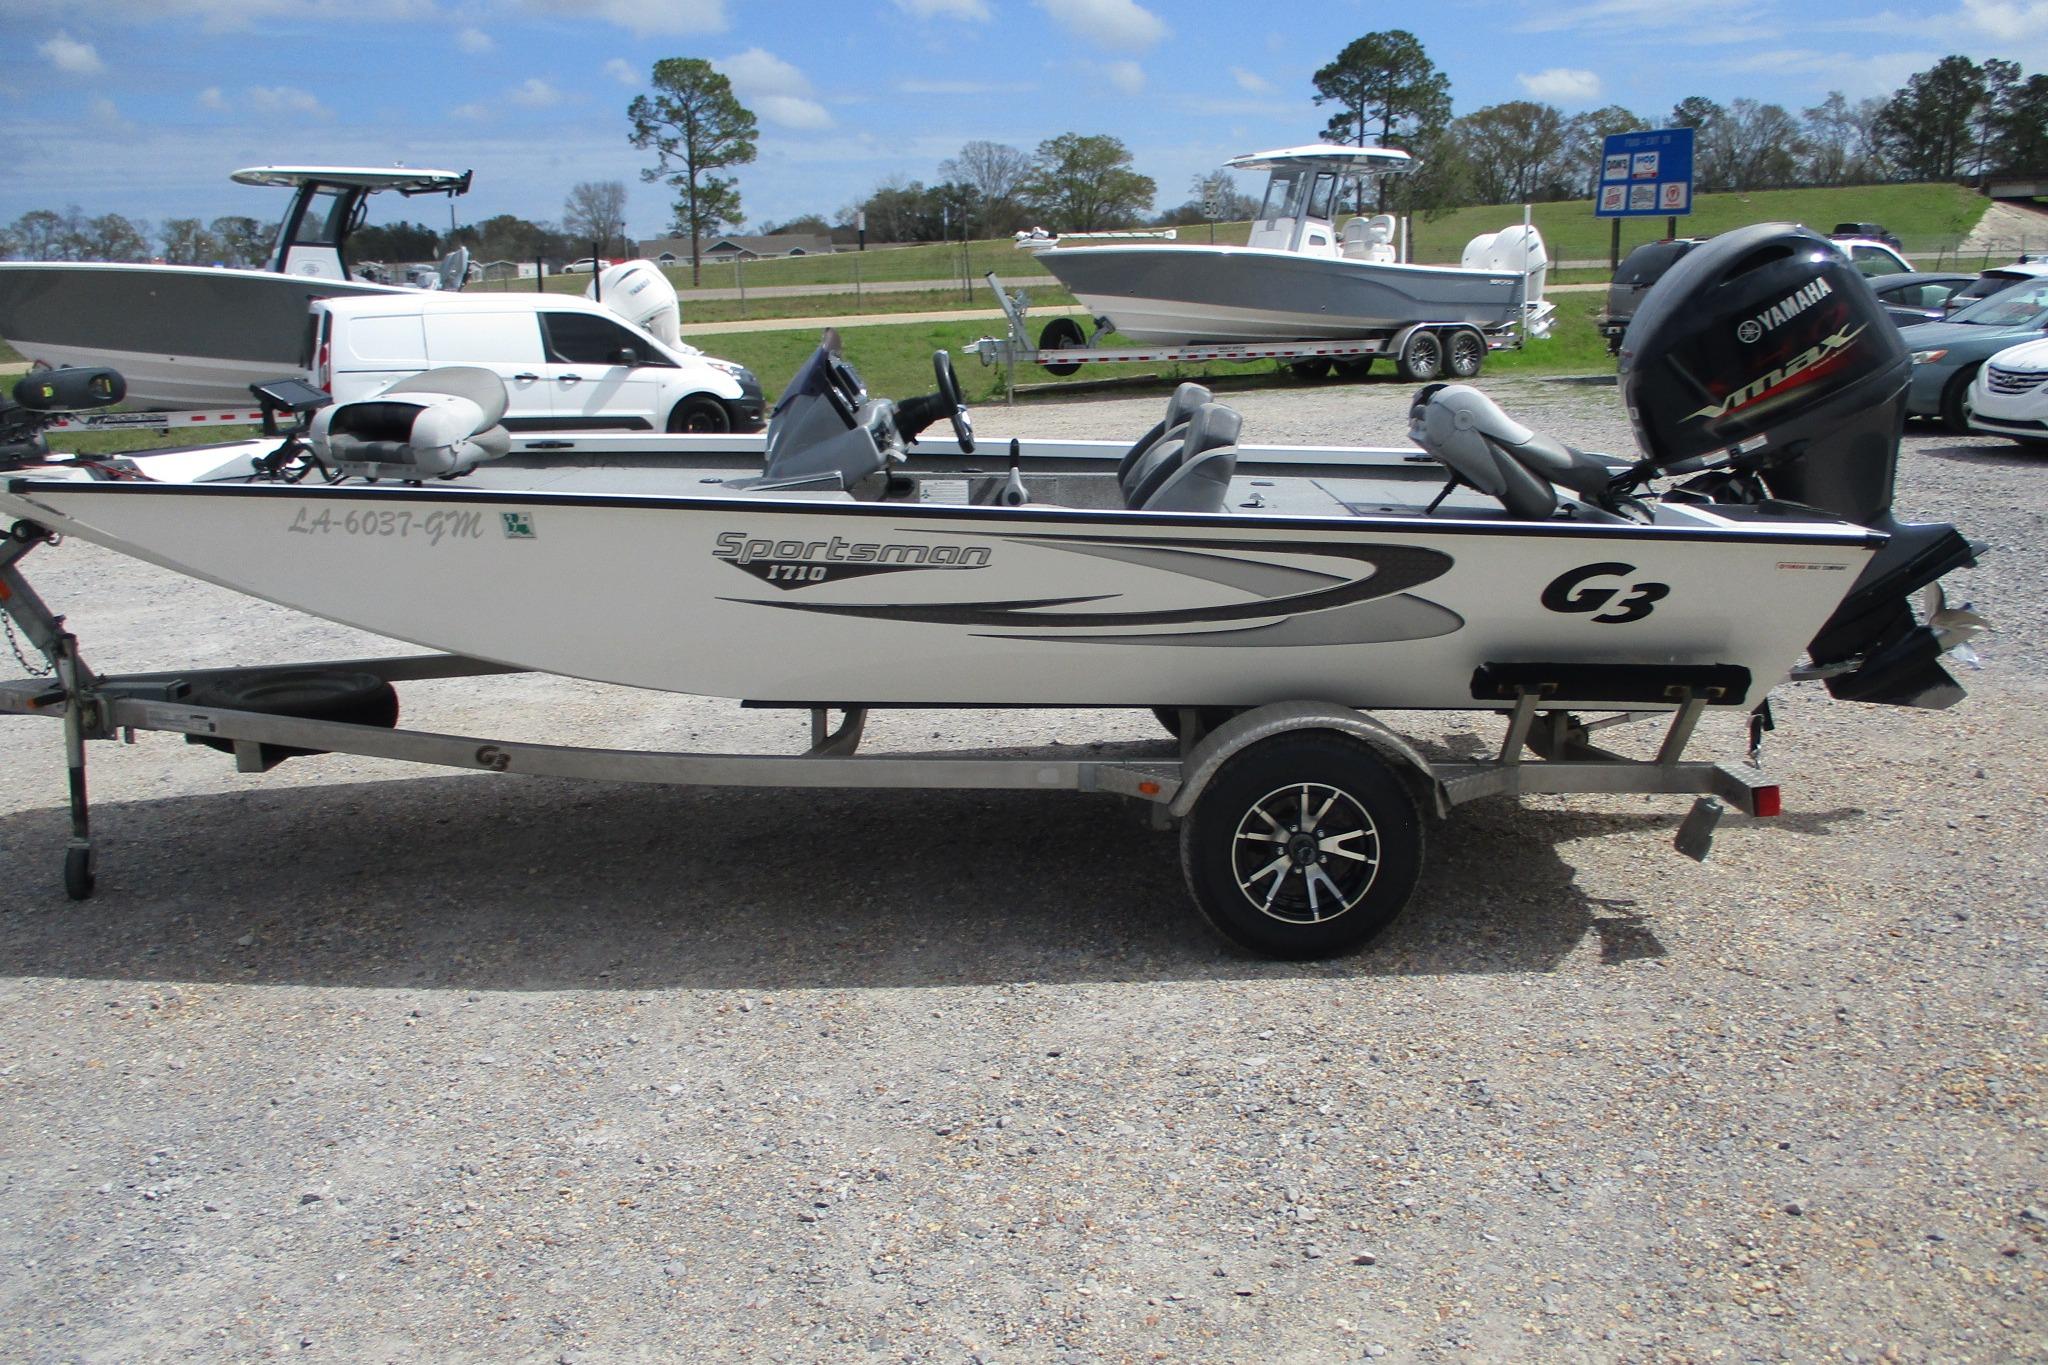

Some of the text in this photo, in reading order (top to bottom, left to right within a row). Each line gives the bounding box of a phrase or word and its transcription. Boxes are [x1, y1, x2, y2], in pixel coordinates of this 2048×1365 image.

[1757, 276, 1833, 331] YAMAHA
[288, 506, 485, 547] LA-6037-GM
[712, 531, 992, 565] Sportsman
[766, 564, 827, 581] 1710
[1541, 562, 1670, 624] G3
[475, 745, 511, 772] G3
